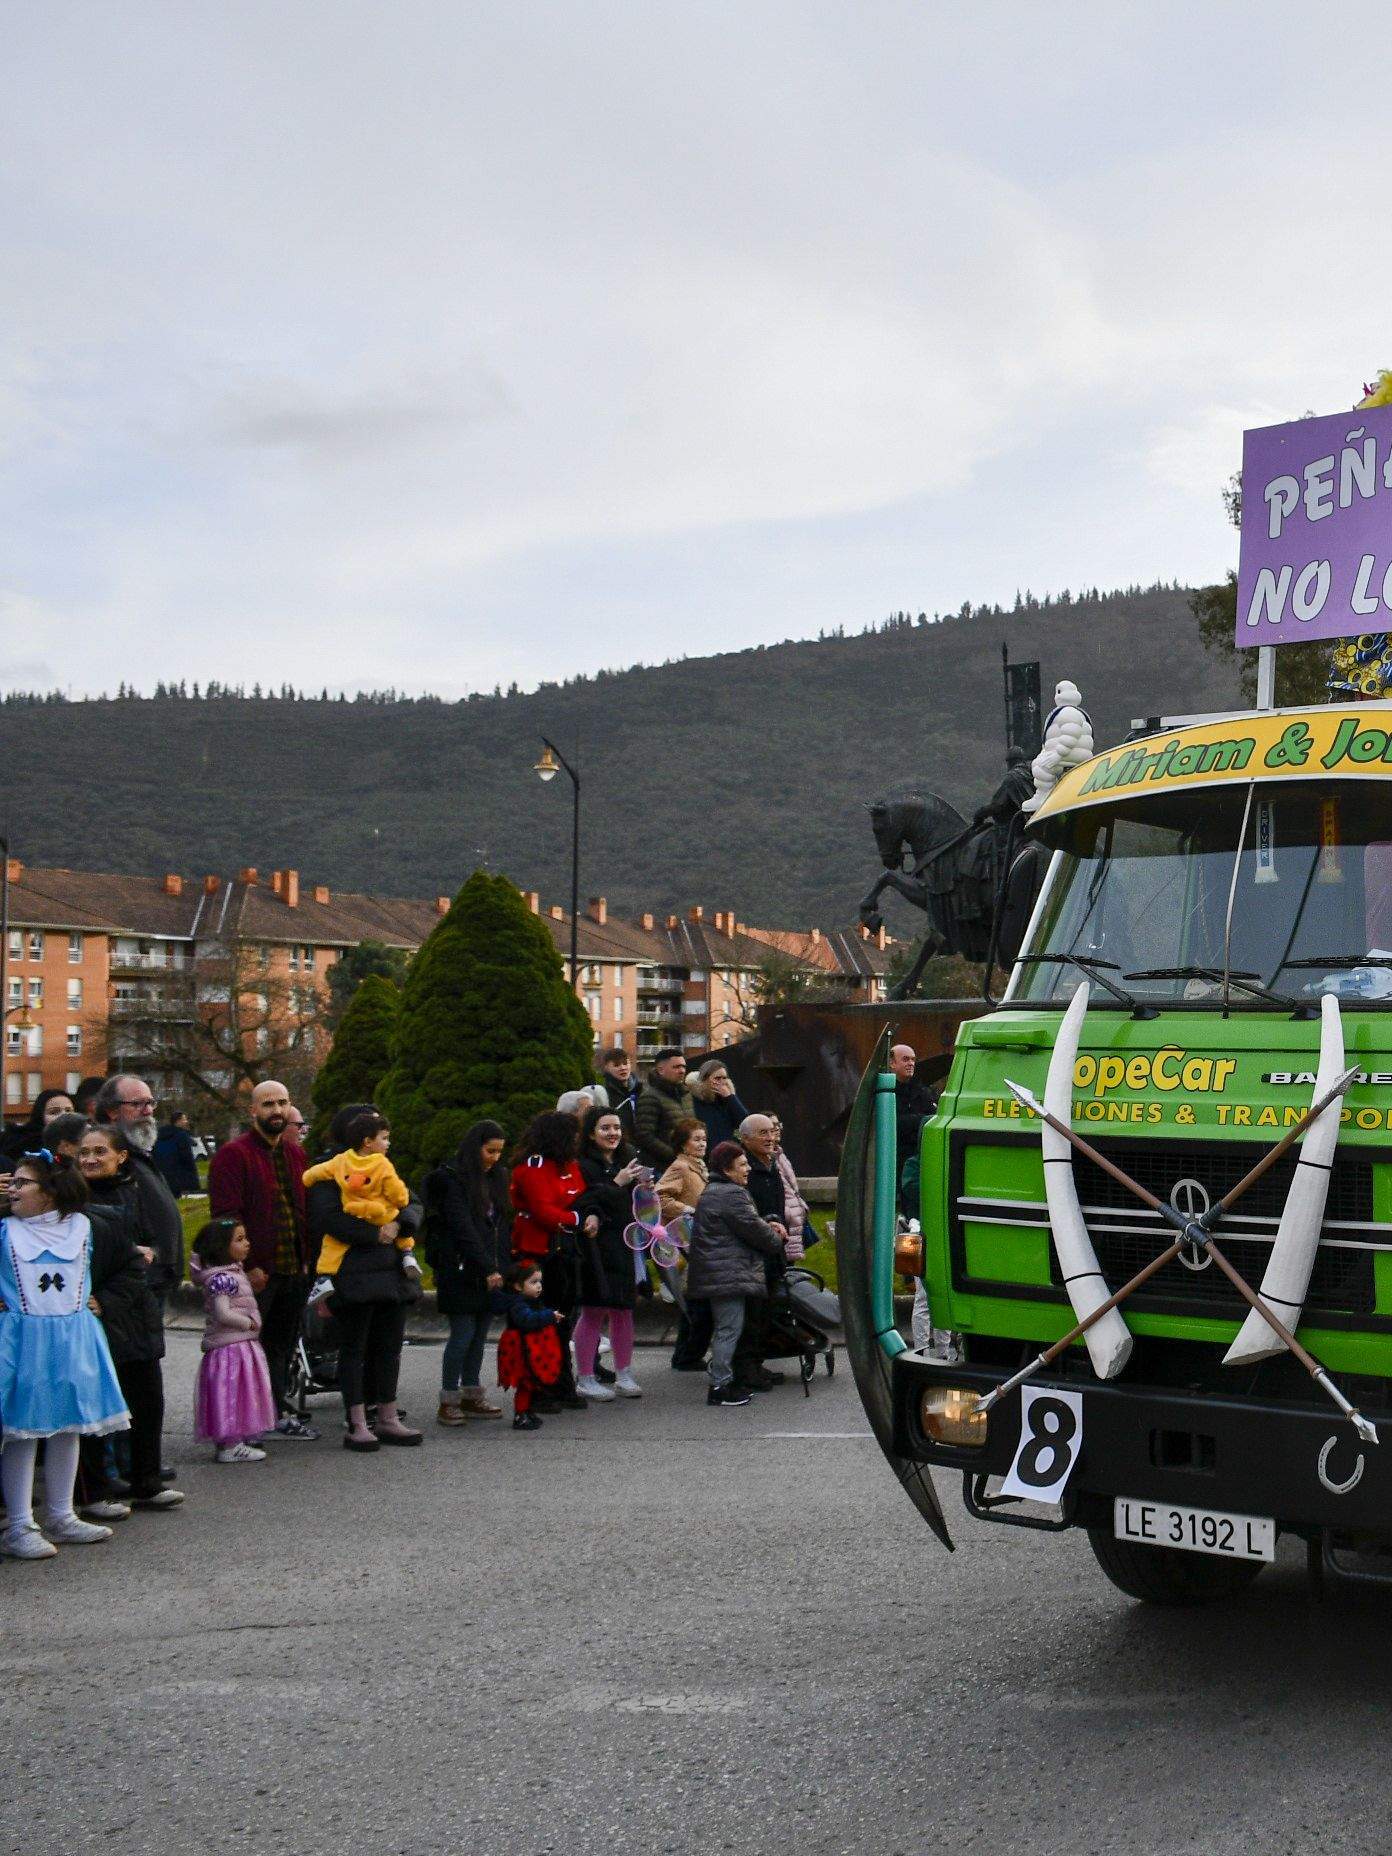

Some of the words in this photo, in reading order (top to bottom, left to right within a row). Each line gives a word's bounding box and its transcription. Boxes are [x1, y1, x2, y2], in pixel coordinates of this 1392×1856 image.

[1246, 559, 1332, 626] NO
[1078, 739, 1256, 796] Miriam
[1264, 721, 1312, 768] &
[1072, 1044, 1237, 1098] opeCar
[983, 1098, 1164, 1123] ELEIONES
[1175, 1103, 1196, 1124] &
[1016, 1396, 1077, 1488] 8
[1125, 1505, 1157, 1540] LE
[1168, 1511, 1236, 1552] 3192
[1247, 1522, 1264, 1556] L
